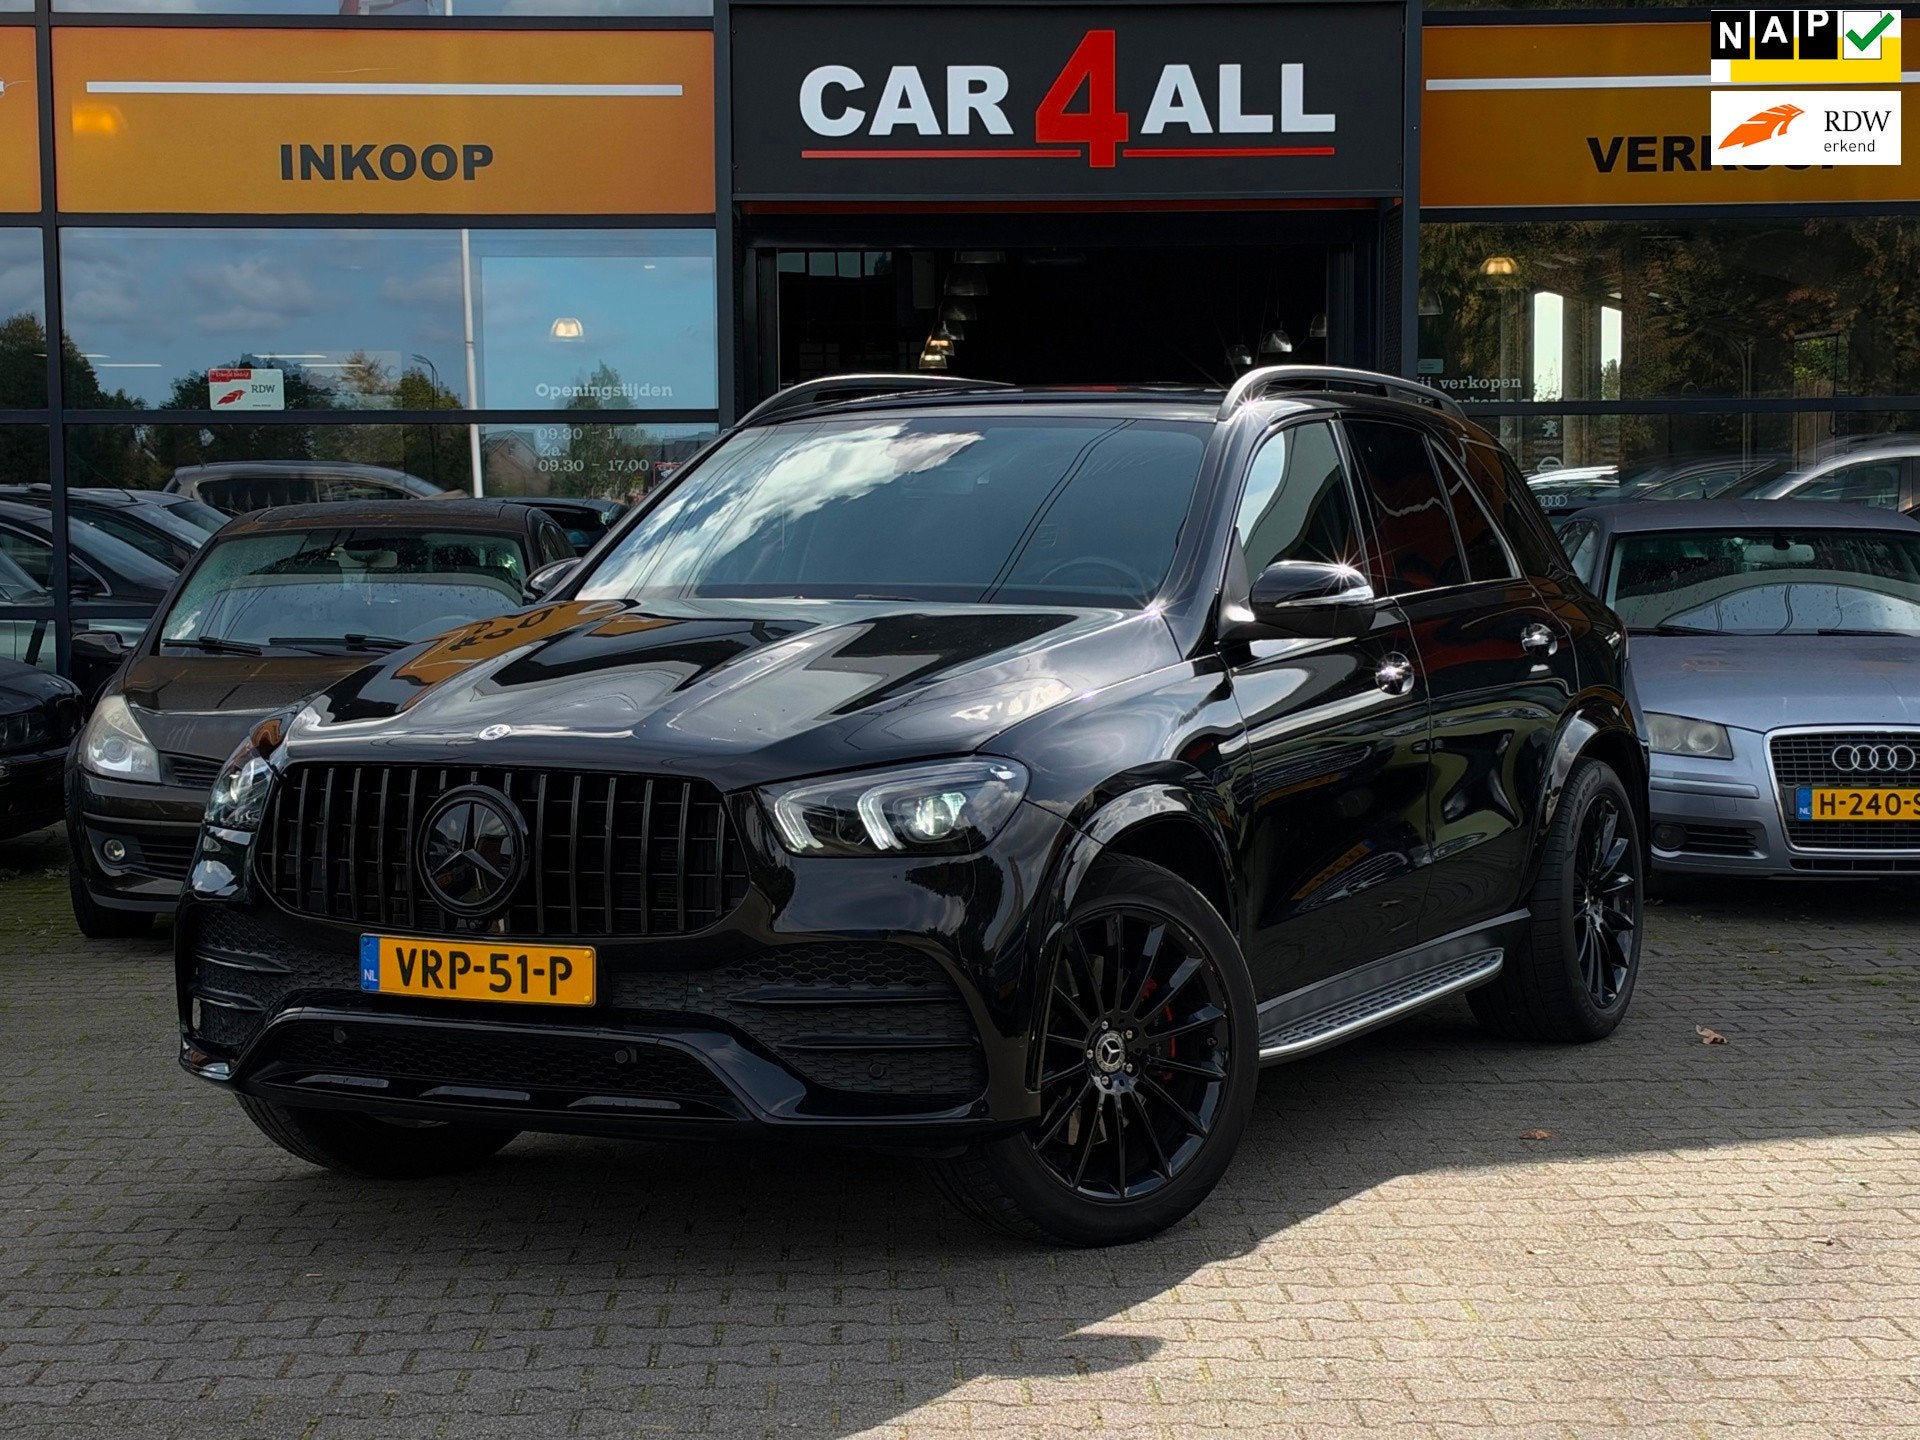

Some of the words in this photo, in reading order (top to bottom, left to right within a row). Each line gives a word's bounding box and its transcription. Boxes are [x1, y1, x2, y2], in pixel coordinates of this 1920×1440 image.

[799, 64, 1014, 137] CAR
[1035, 29, 1129, 168] 4
[1140, 63, 1336, 134] ALL
[280, 144, 493, 182] INKOOP
[251, 384, 276, 394] RDW
[535, 382, 673, 400] Openingstijden
[1439, 376, 1522, 392] verkopen
[537, 427, 583, 440] 09.30
[538, 459, 585, 472] 09.30
[608, 459, 649, 472] 17.00
[1799, 807, 1810, 815] NL
[363, 971, 378, 982] NL
[395, 947, 573, 994] VRP-51-P
